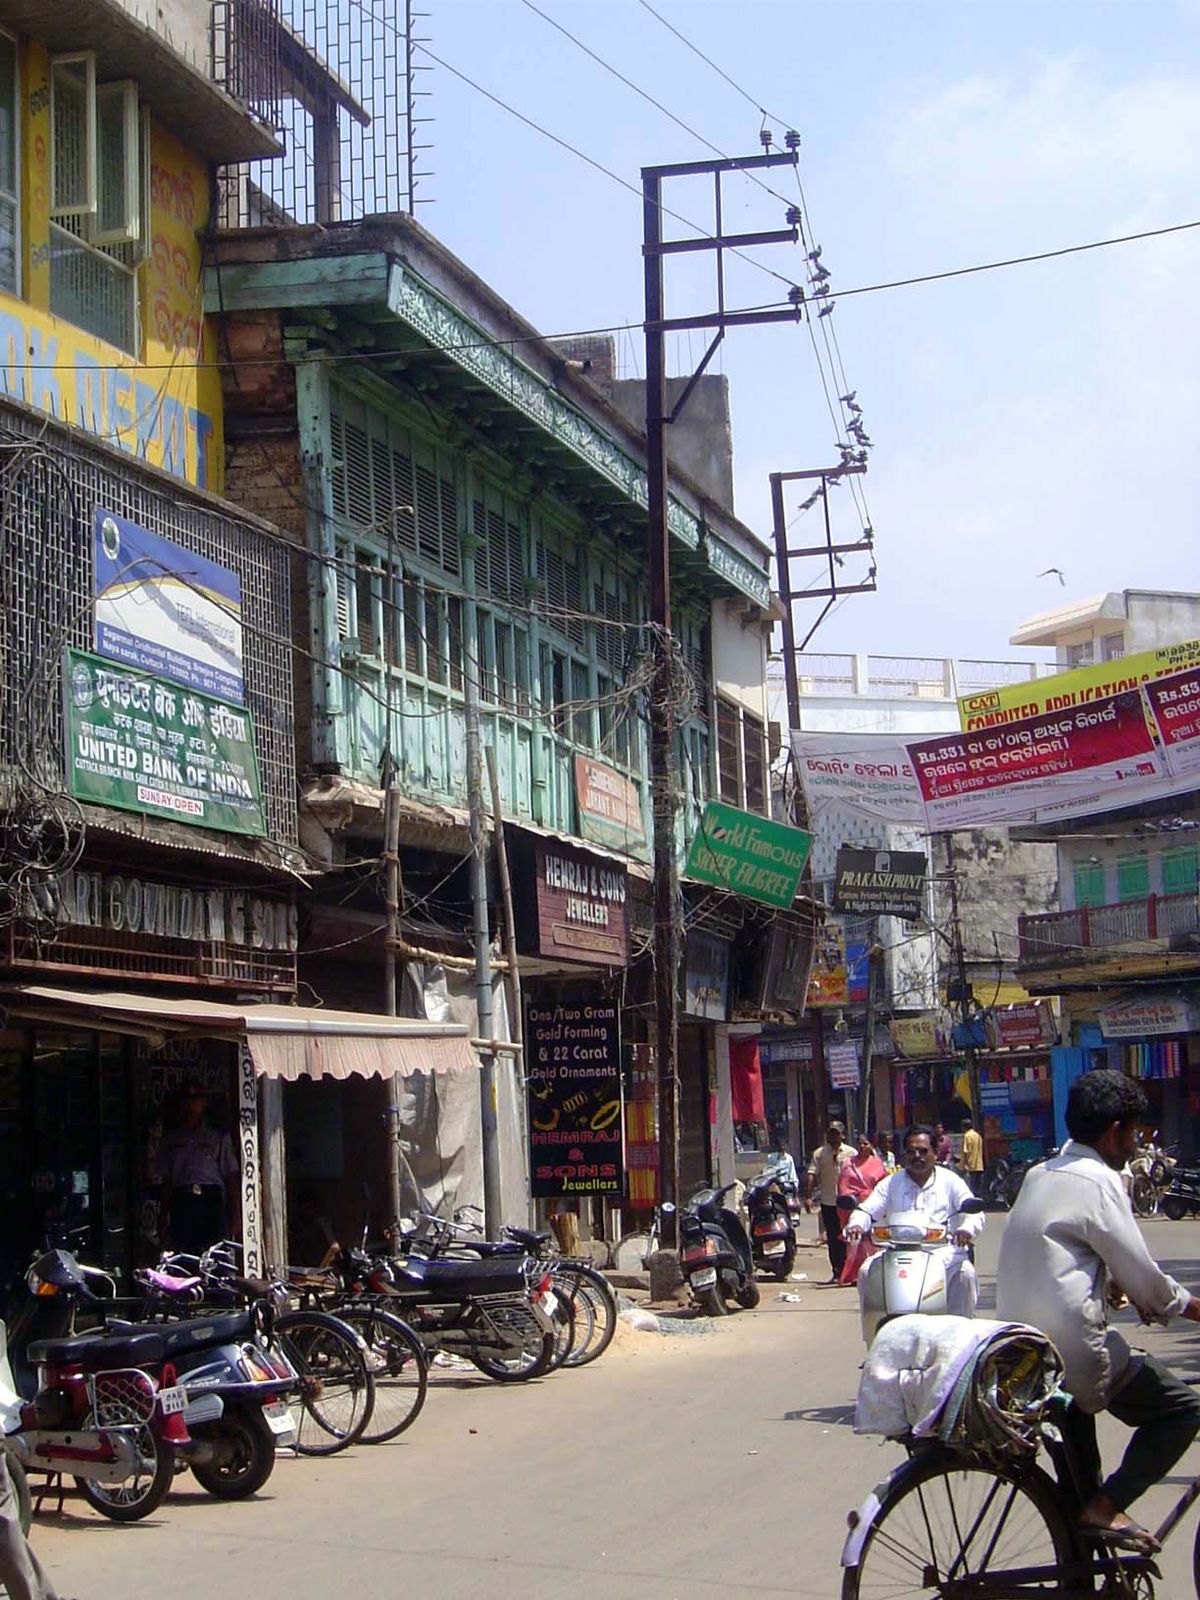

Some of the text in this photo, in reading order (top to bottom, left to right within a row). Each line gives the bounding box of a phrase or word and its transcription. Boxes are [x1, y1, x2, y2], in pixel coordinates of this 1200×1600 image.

[75, 348, 213, 490] DEPOT
[969, 695, 996, 710] CAT
[79, 735, 137, 769] UNITED
[143, 752, 184, 784] BANK
[186, 765, 207, 787] OF
[210, 772, 253, 799] INDIA
[855, 762, 898, 777] ହେଲା
[140, 789, 173, 805] SUNDAY
[174, 798, 202, 813] OPEN
[545, 855, 626, 903] HEMRAJ & SONS
[736, 861, 793, 899] FILIGREE
[566, 897, 608, 925] JEWELLERS
[584, 1006, 615, 1019] Gram
[536, 1025, 607, 1040] Gold Forming
[539, 1045, 608, 1061] & 22 Carat
[531, 1065, 616, 1079] Gold Ornaments
[532, 1130, 620, 1144] HEMRAJ
[568, 1148, 584, 1161] &
[536, 1164, 616, 1178] SONS
[562, 1176, 617, 1190] Jewellers
